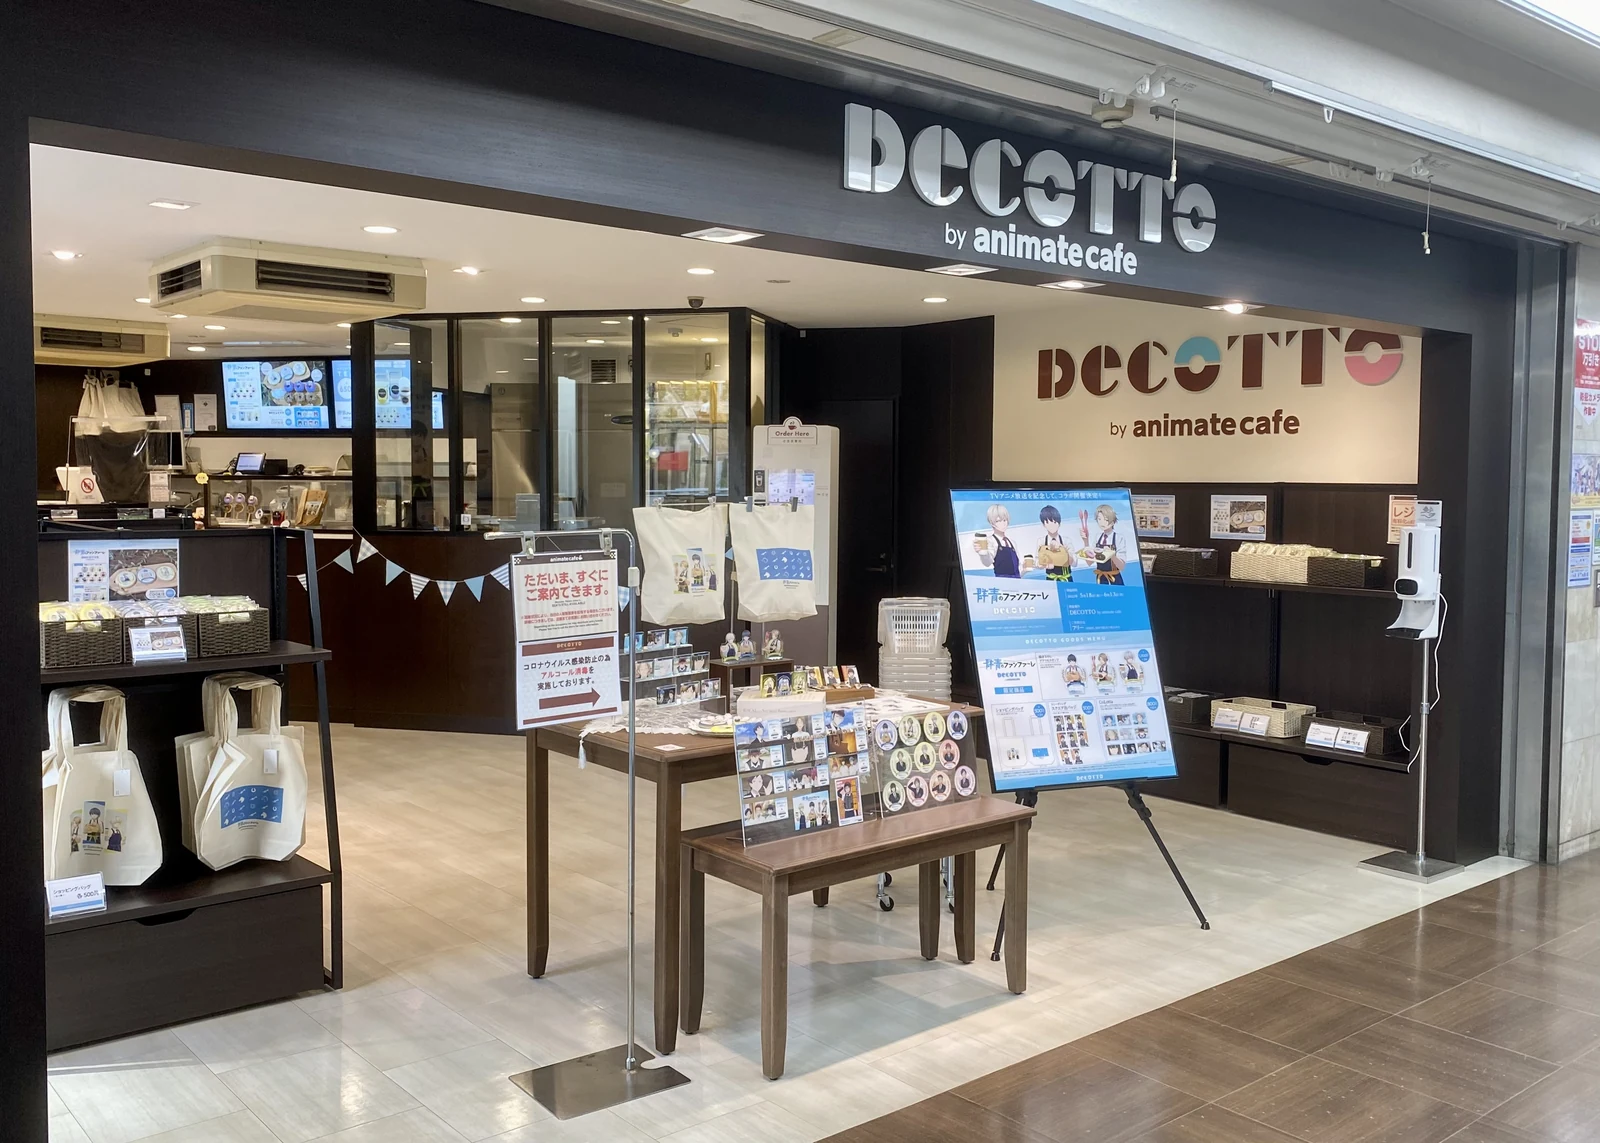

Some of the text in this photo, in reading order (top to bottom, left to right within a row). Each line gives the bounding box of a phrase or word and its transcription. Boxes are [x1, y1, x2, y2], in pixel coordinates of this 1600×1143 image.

[944, 222, 967, 250] by
[1579, 335, 1600, 351] STO
[1110, 421, 1127, 439] by
[524, 569, 609, 587] ただいま、すぐに
[526, 584, 609, 602] ご案内できます。
[523, 654, 611, 671] コロナウイルス感染防止の為
[541, 666, 594, 679] アルコール消毒を
[537, 679, 595, 691] 実施しております。
